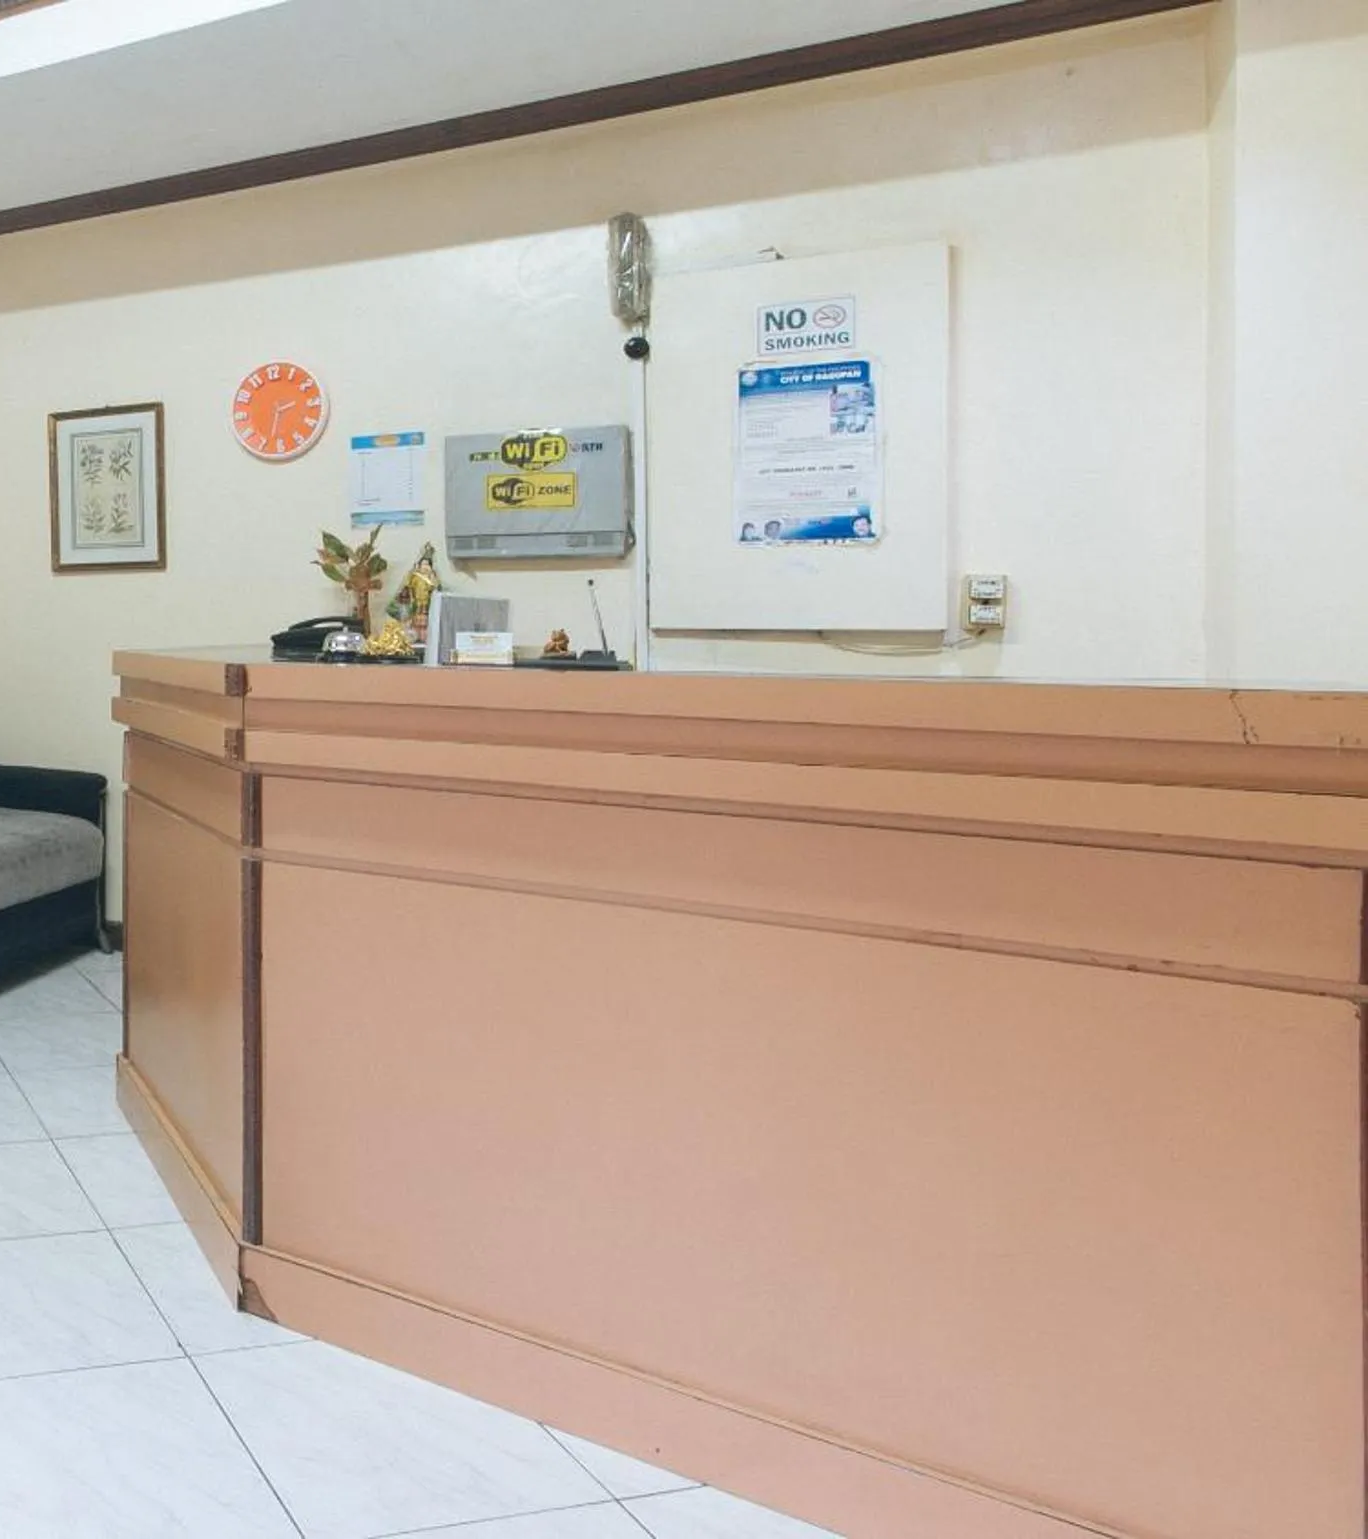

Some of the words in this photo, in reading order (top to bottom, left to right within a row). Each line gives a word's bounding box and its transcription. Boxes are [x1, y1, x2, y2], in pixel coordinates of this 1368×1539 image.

[765, 308, 807, 332] NO
[764, 331, 850, 351] SMOKING
[266, 364, 281, 381] 12
[288, 367, 296, 381] 1
[779, 374, 800, 385] CITY
[801, 373, 814, 383] OF
[248, 374, 264, 389] 11
[299, 378, 313, 392] 2
[236, 388, 251, 404] 10
[258, 436, 268, 451] 7
[292, 431, 305, 446] 5
[537, 485, 572, 496] ZONE
